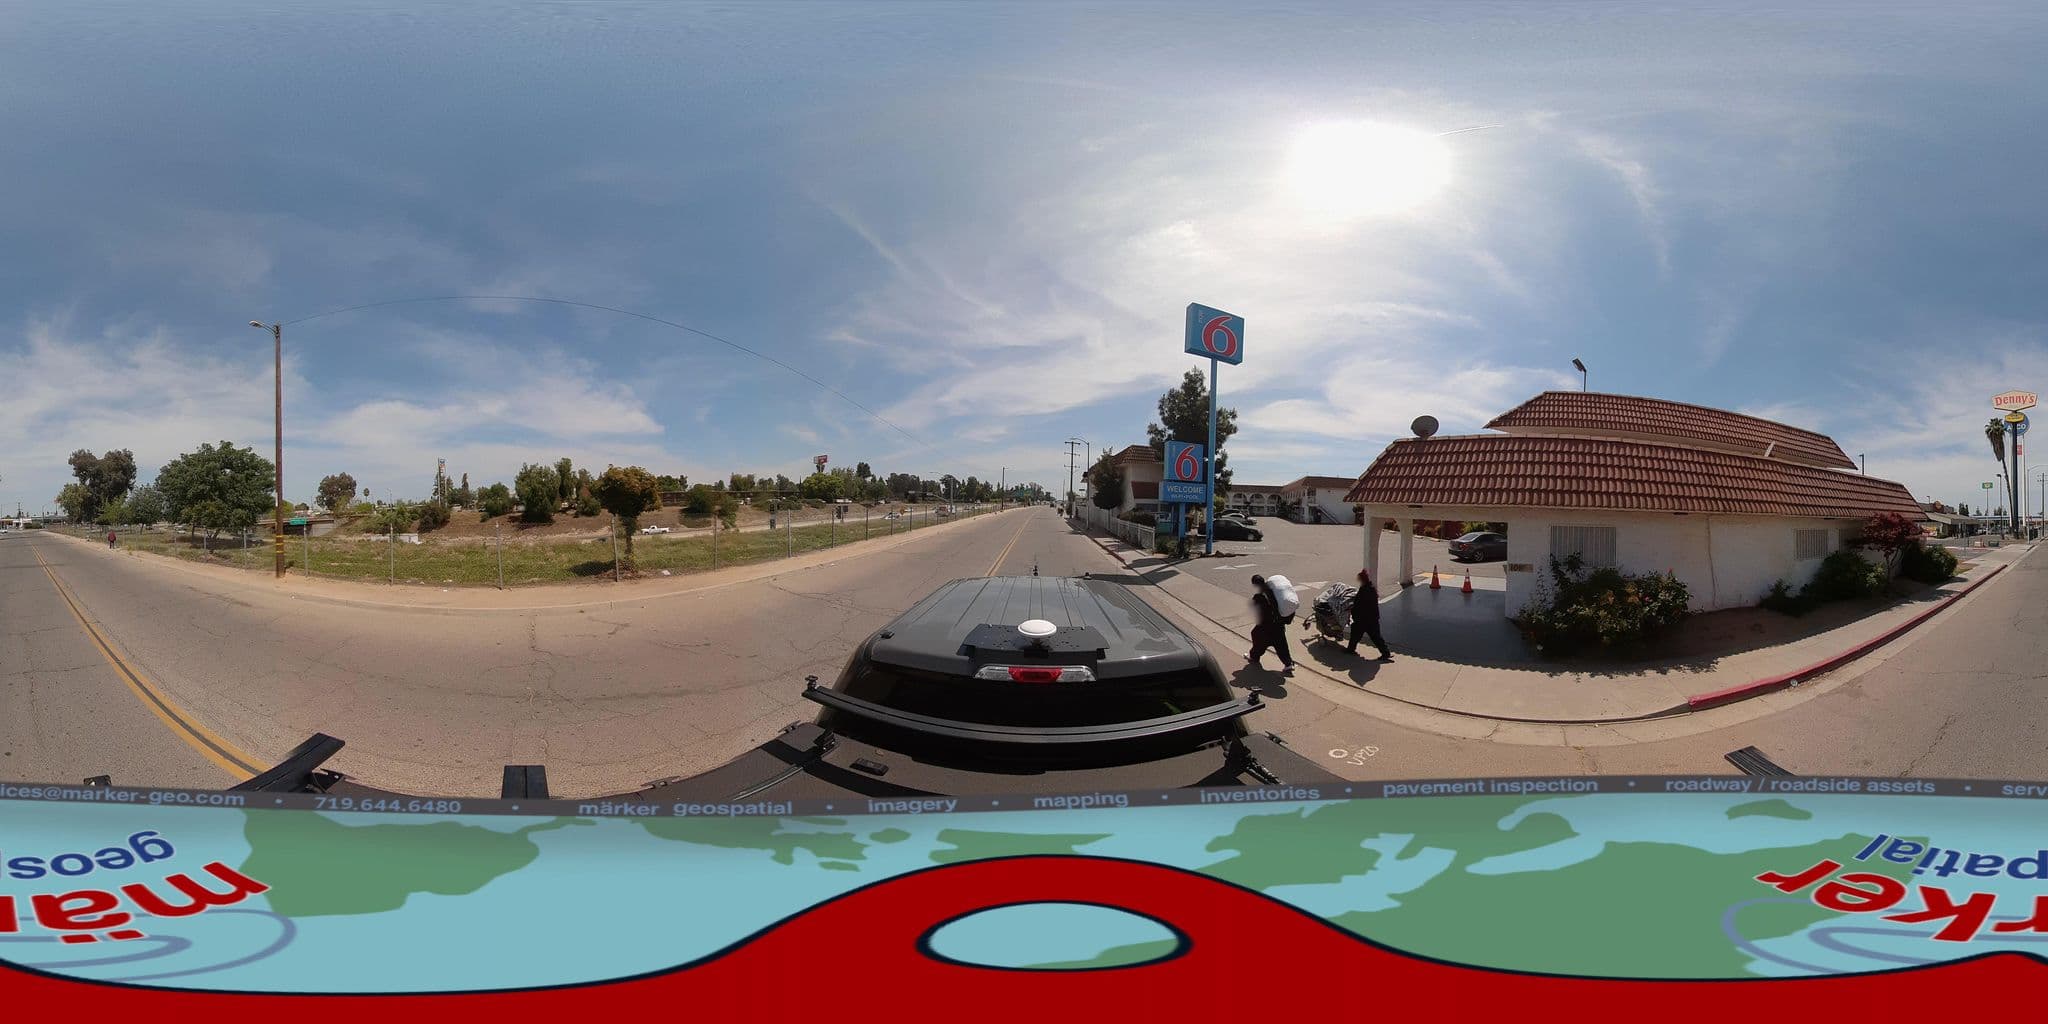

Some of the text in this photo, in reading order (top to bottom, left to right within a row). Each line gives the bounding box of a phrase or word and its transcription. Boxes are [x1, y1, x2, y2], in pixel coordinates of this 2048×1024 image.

[1202, 315, 1237, 357] 6
[1995, 394, 2035, 406] Denny's
[1175, 444, 1199, 482] 6
[1167, 485, 1204, 494] WELCOME
